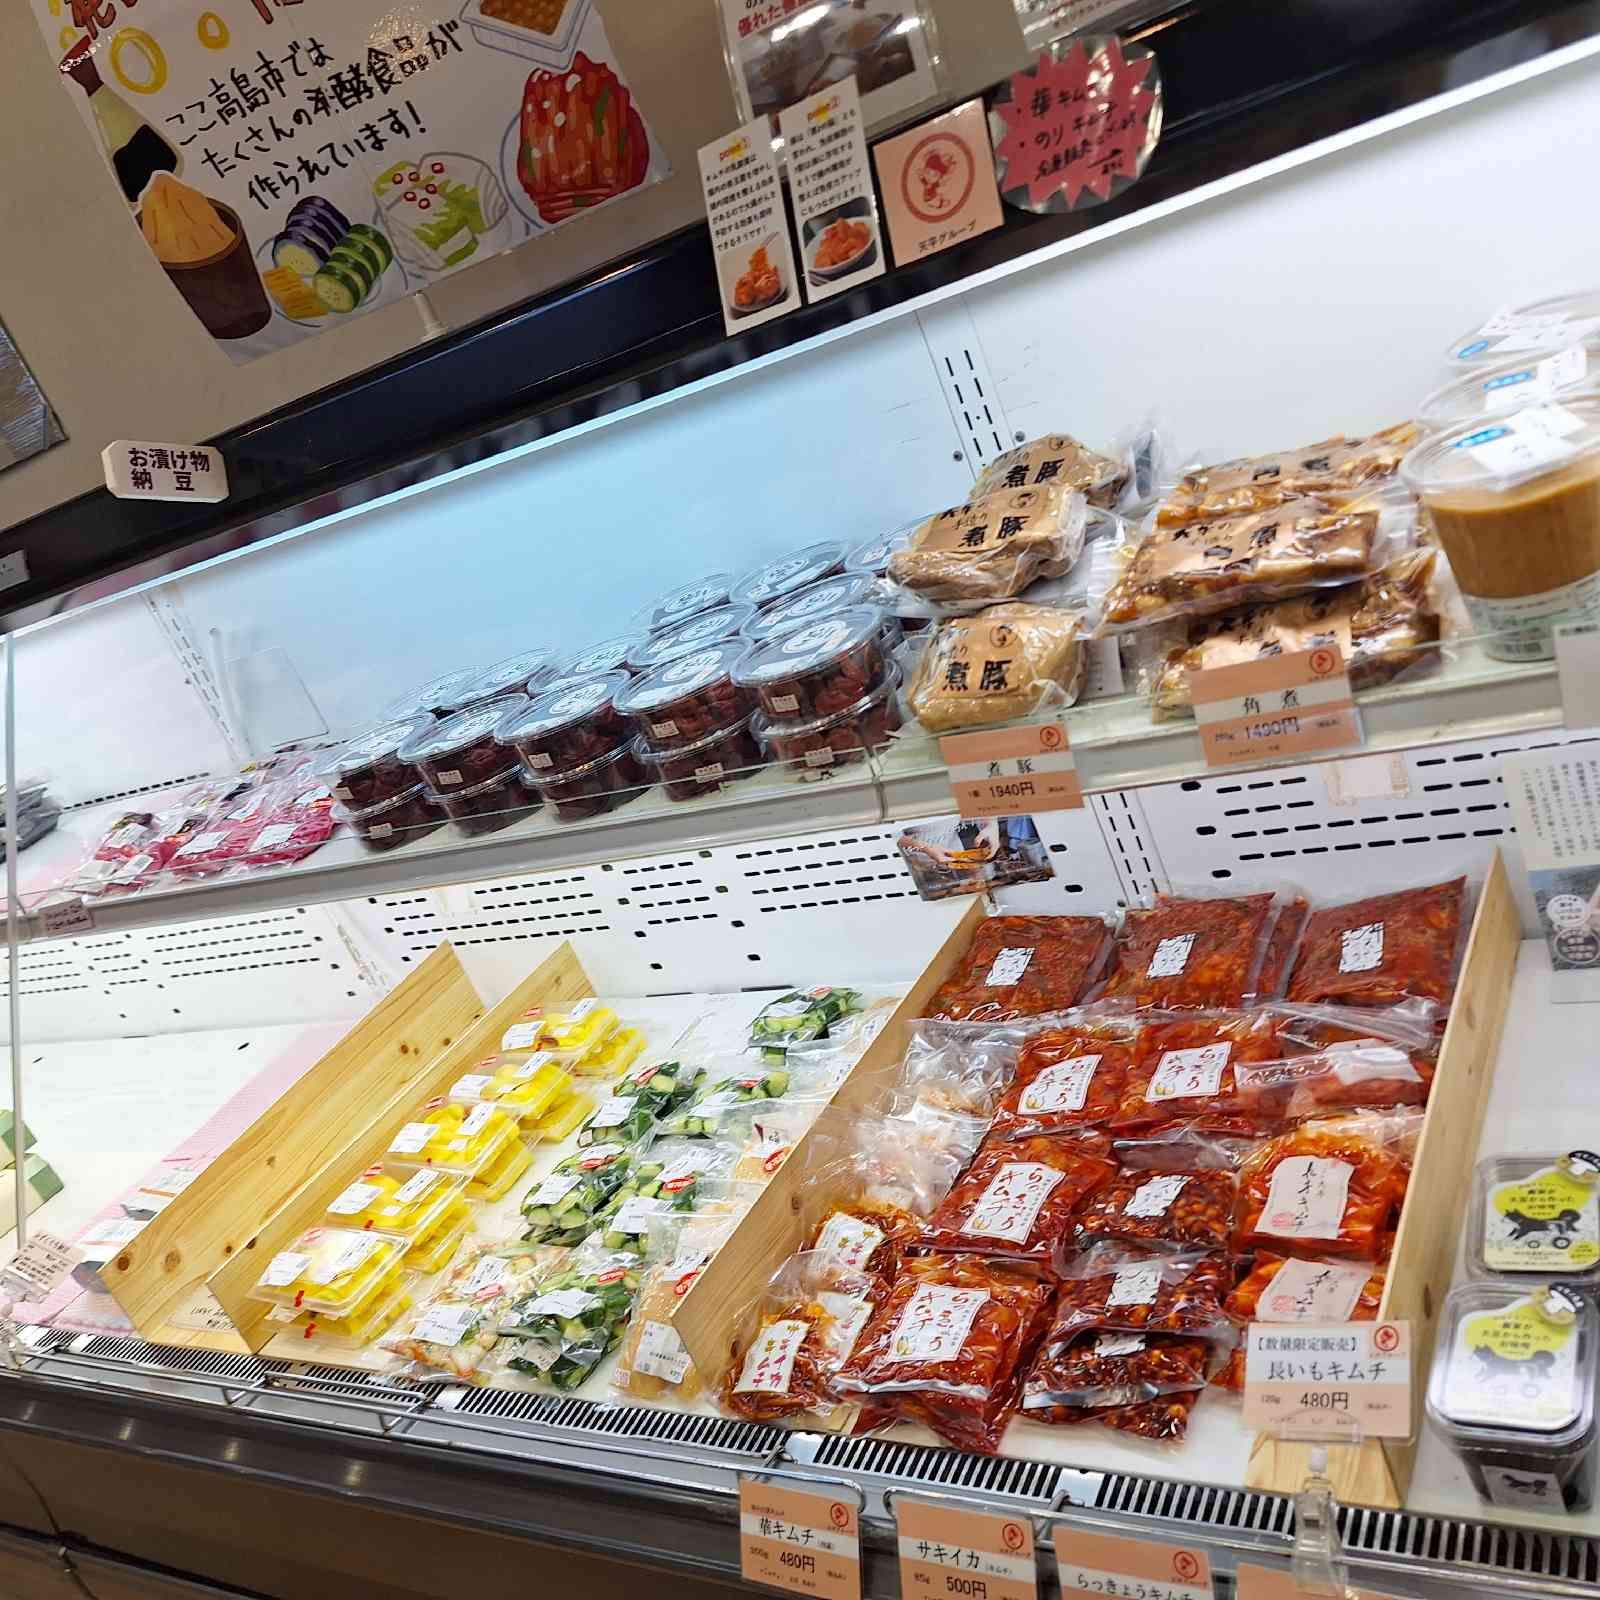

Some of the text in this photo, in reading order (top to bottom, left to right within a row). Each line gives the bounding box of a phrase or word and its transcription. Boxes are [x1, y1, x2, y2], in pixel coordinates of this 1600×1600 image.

[166, 38, 334, 146] ここ高島市では
[128, 447, 210, 472] お漬け物
[1001, 457, 1066, 489] 煮豚
[958, 514, 1031, 548] 煮豚
[942, 658, 1014, 692] 煮豚
[1257, 1335, 1360, 1352] 【数量限定販売】
[1266, 1360, 1388, 1382] 長いもキムチ
[1300, 1391, 1349, 1410] 480円
[779, 1551, 816, 1574] 480円
[916, 1540, 981, 1569] サキイカ
[945, 1575, 988, 1600] 500円
